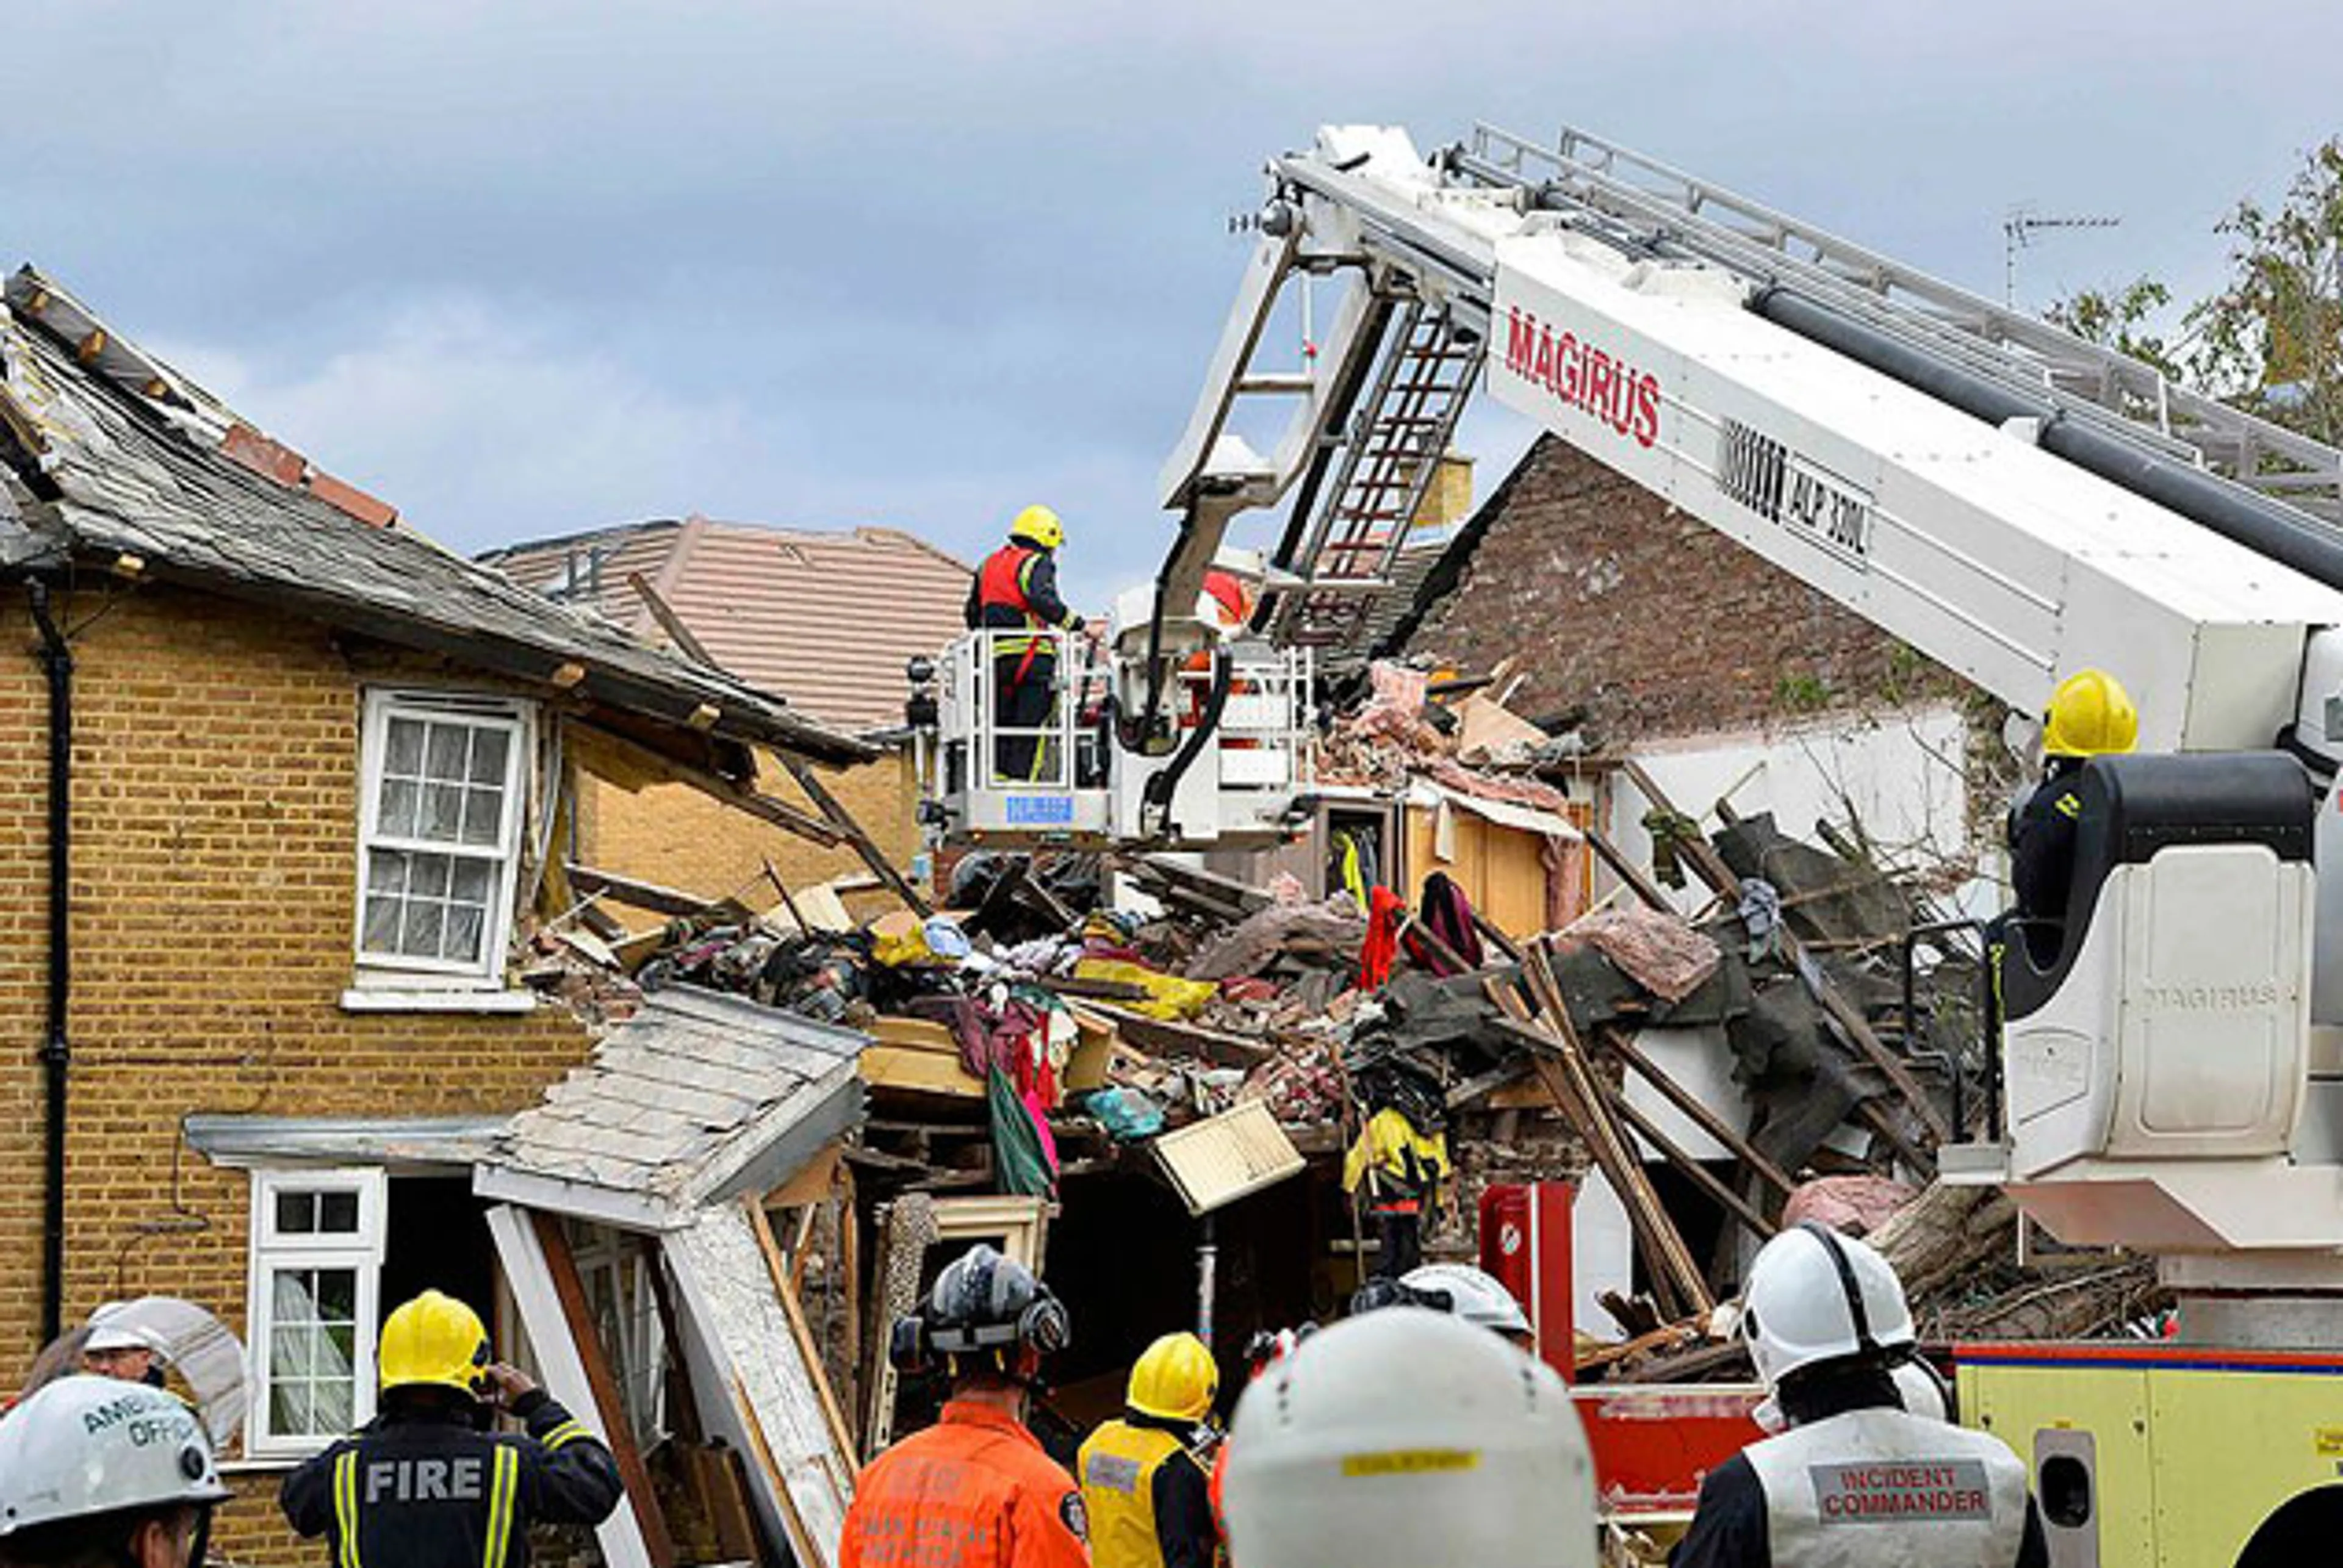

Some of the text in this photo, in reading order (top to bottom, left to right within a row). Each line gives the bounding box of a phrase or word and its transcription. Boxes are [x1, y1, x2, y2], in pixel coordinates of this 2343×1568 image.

[1505, 305, 1660, 448] MAGIRUS
[1788, 470, 1824, 528] ALP
[2142, 984, 2278, 1009] MAGIRUS
[365, 1458, 481, 1503] FIRE
[1841, 1467, 1956, 1489] INCIDENT
[1824, 1490, 1985, 1516] COMMANDER
